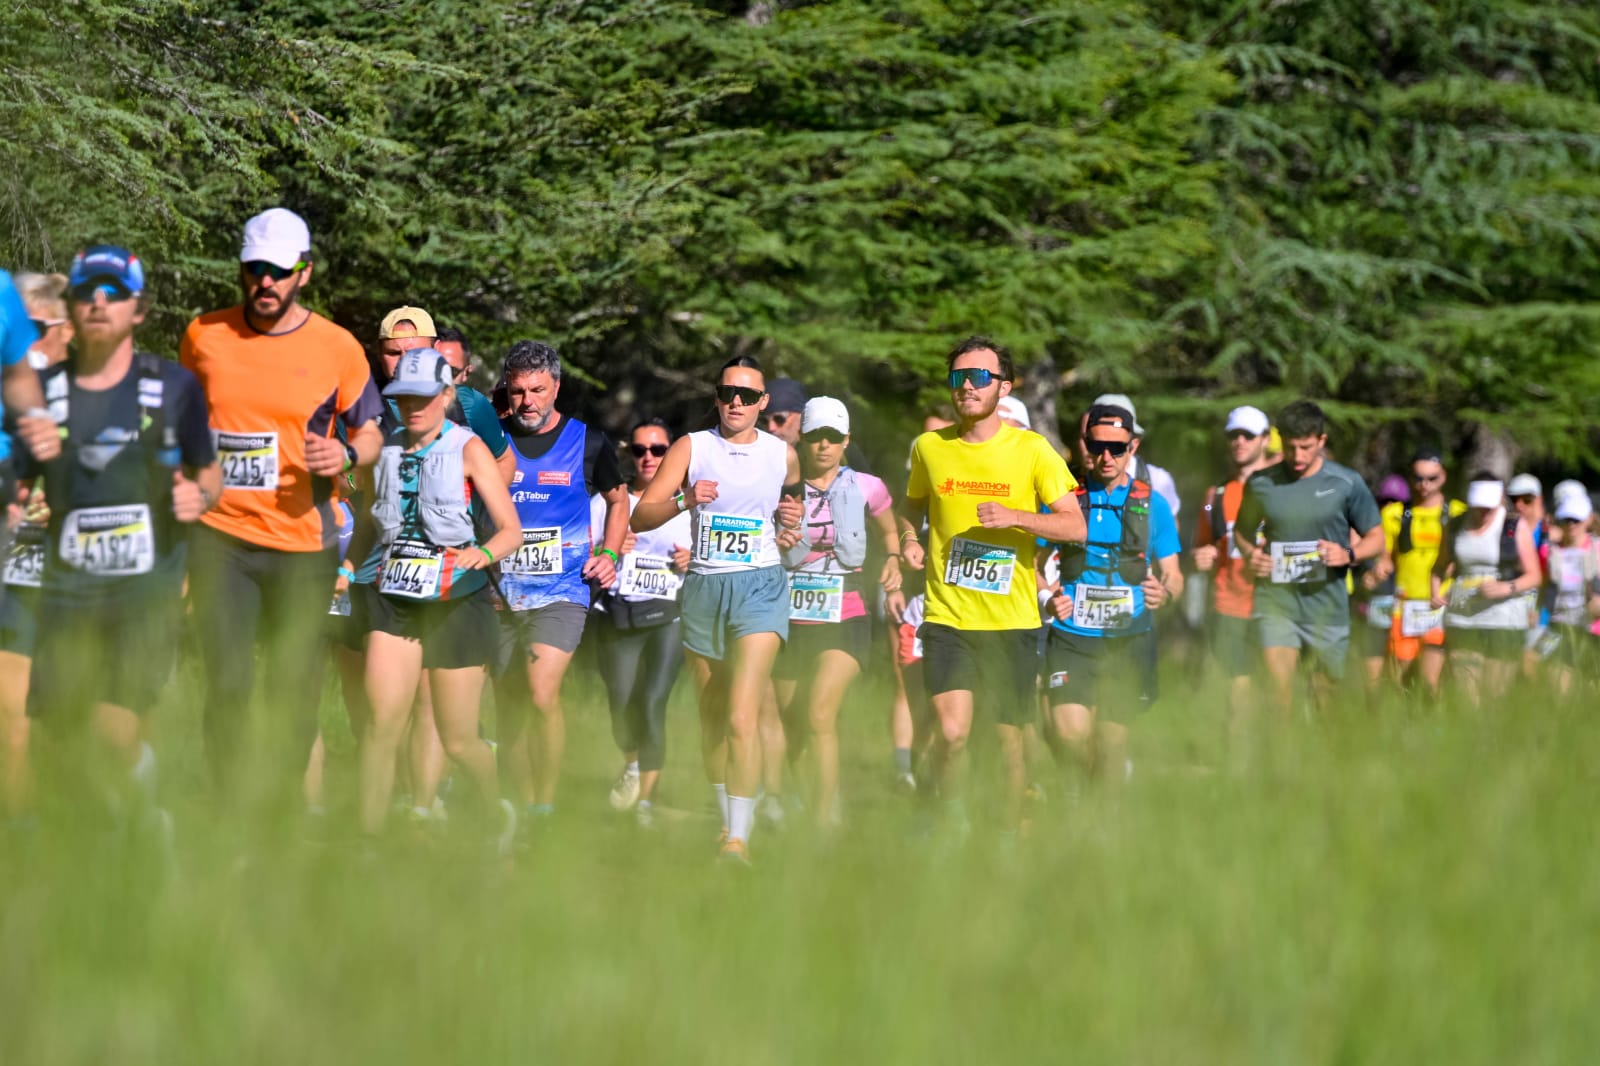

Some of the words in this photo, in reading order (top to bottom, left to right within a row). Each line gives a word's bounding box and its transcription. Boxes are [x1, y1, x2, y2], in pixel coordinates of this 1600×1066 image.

[524, 491, 550, 500] Tabur
[956, 481, 1010, 491] MARATHON
[714, 517, 756, 528] MARATHON
[522, 532, 551, 541] RATHON
[714, 531, 749, 555] 125
[513, 545, 549, 567] 4134
[966, 543, 1008, 556] MARATHON
[386, 561, 422, 586] 4044
[962, 558, 998, 583] 056
[635, 571, 667, 591] 4003
[793, 589, 827, 611] 099
